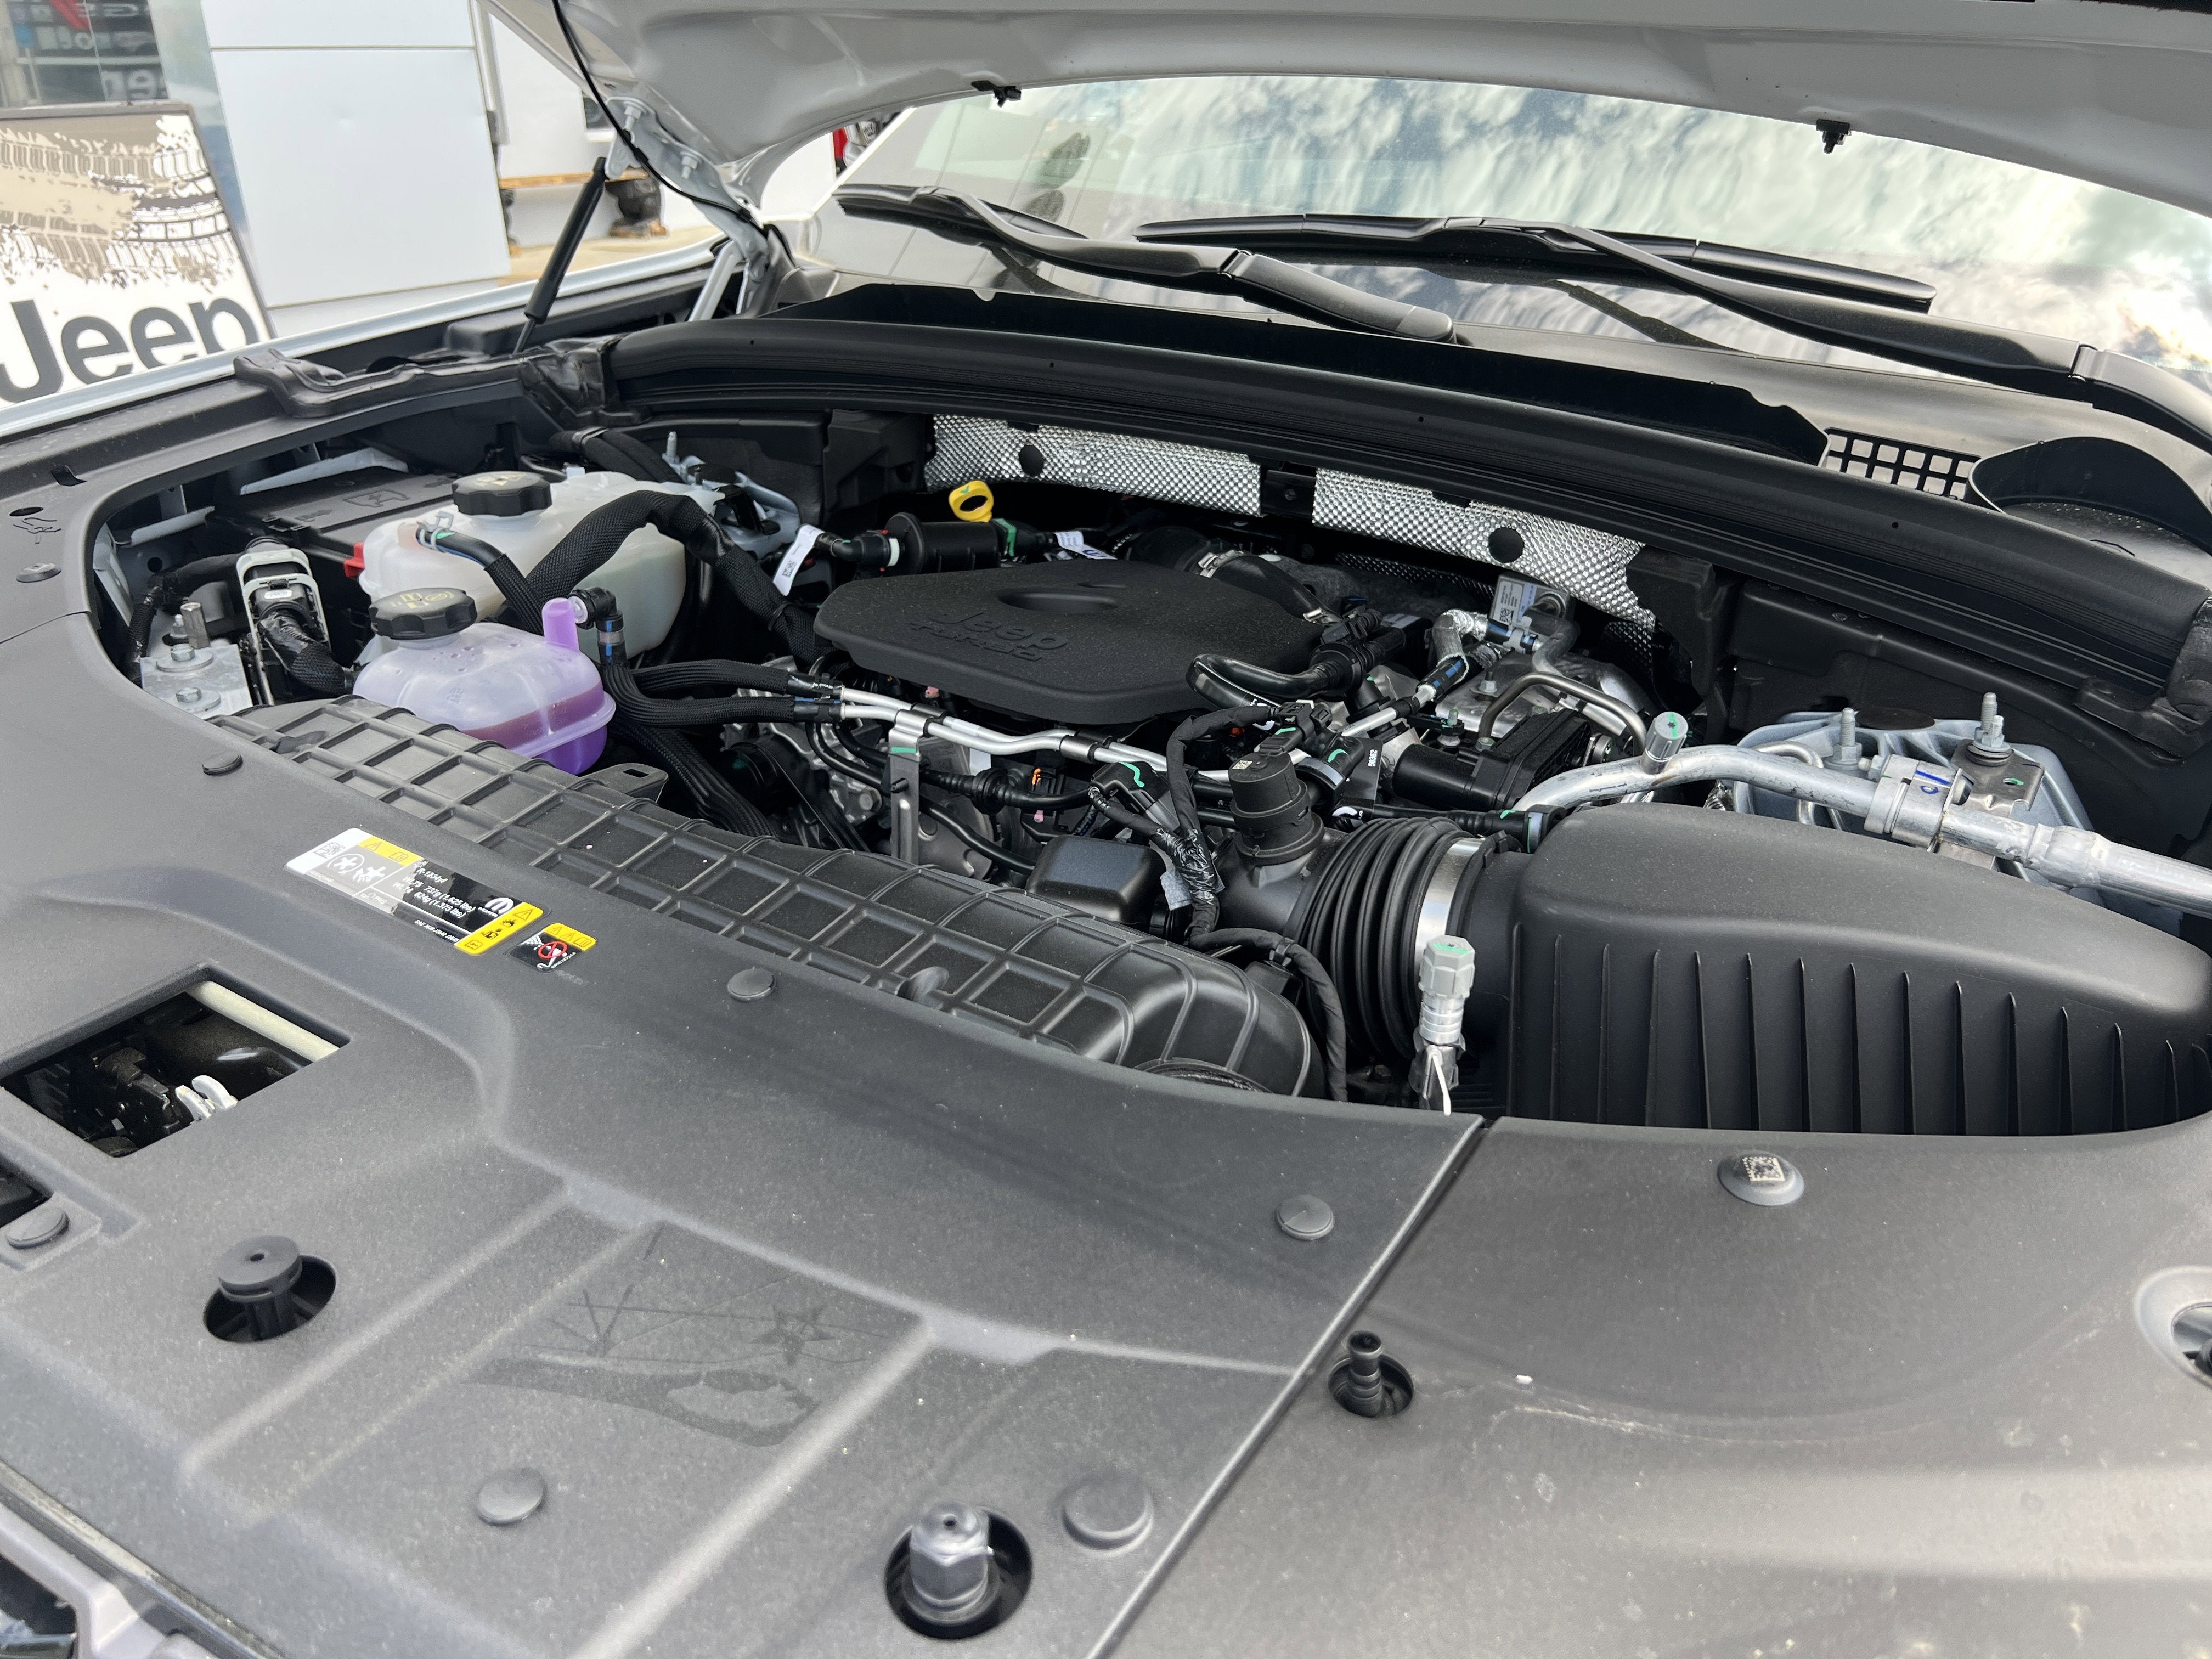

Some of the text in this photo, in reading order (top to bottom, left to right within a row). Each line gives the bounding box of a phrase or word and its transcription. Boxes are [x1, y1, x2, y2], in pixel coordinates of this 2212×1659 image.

[929, 612, 1069, 651] Jeep
[416, 867, 448, 883] R-1234yf
[373, 896, 387, 904] PAG
[393, 882, 466, 919] WL74 624g (1.375 lbs)
[403, 876, 476, 913] WL75 737g (1.625 lbs)
